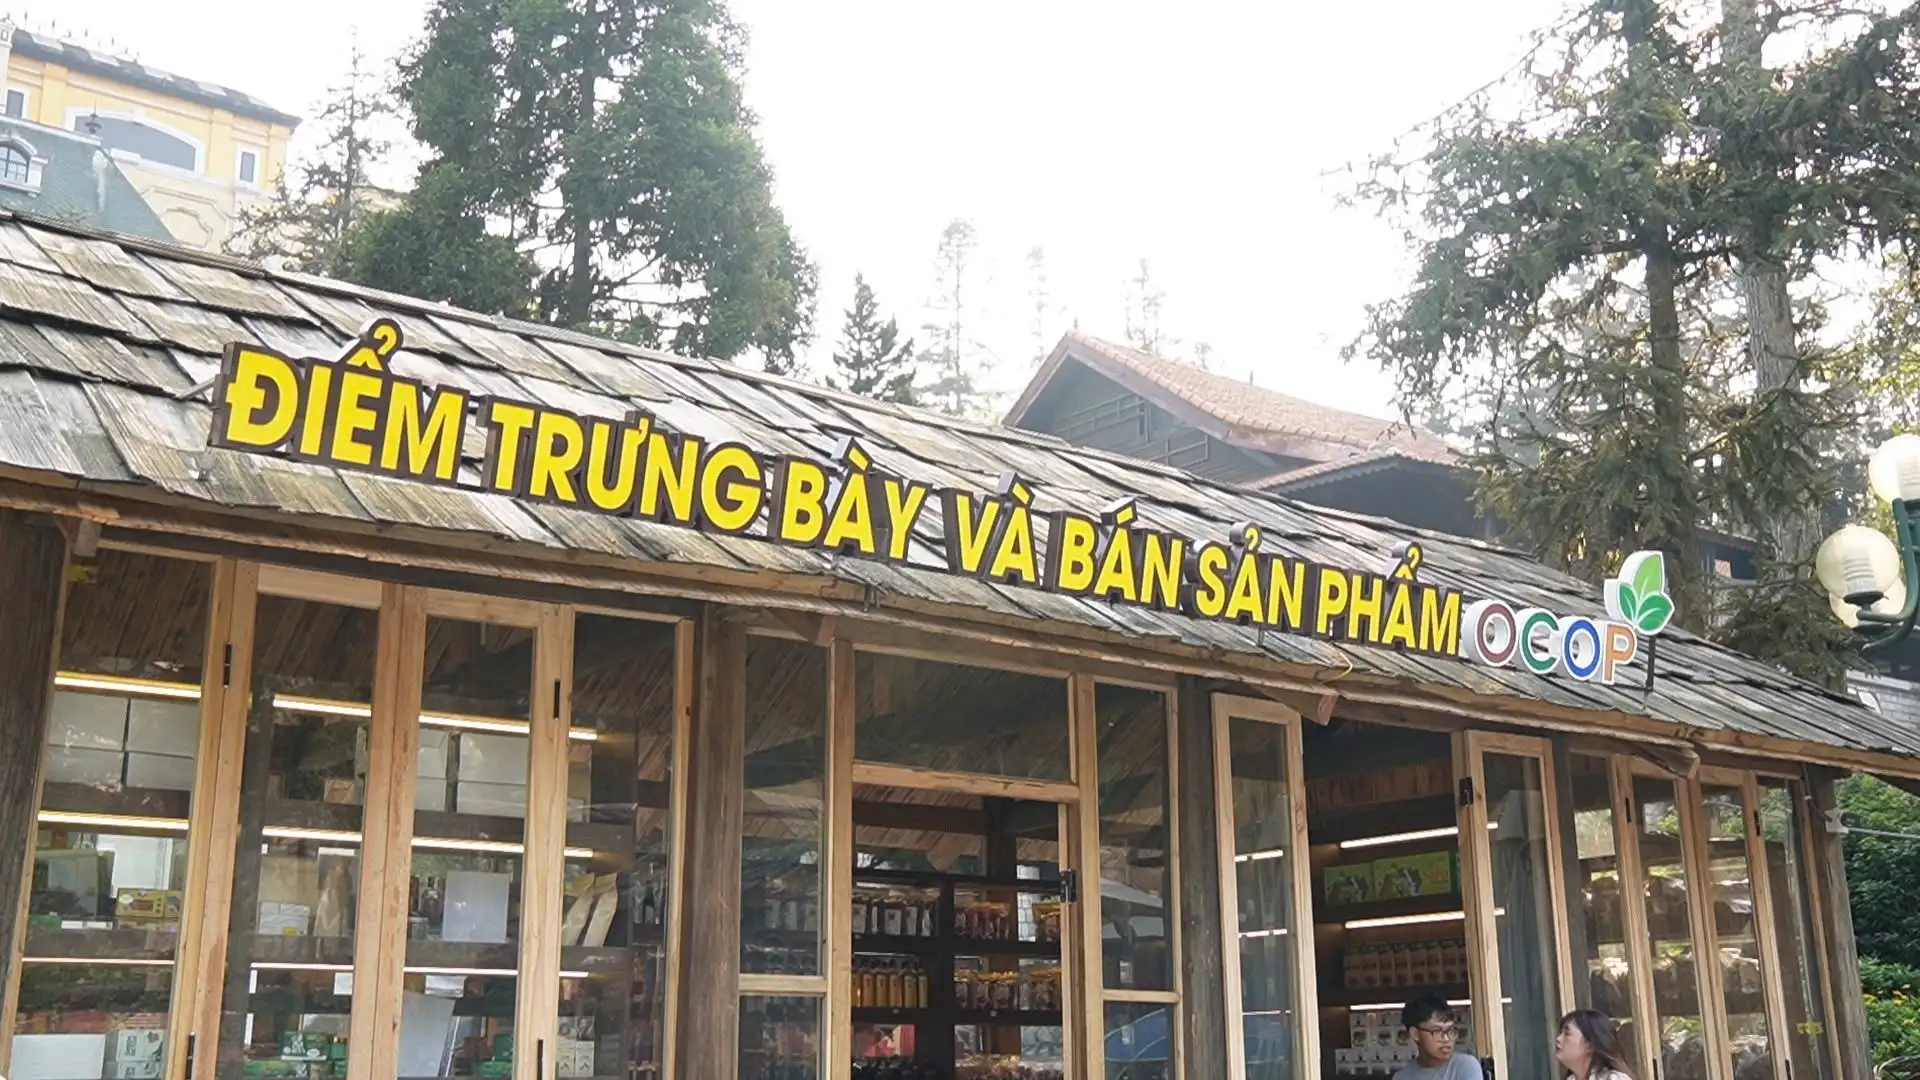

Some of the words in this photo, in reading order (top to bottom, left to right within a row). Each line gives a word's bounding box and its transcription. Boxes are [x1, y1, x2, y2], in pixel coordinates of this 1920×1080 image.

[225, 323, 464, 481] ĐIỂM
[491, 401, 762, 531] TRƯNG
[780, 446, 926, 560] BÀY
[956, 483, 1036, 583] VÀ
[1058, 506, 1183, 609] BÁN
[1195, 527, 1305, 629] SẢN
[1316, 546, 1461, 655] PHẨM
[1474, 601, 1637, 684] OCOP
